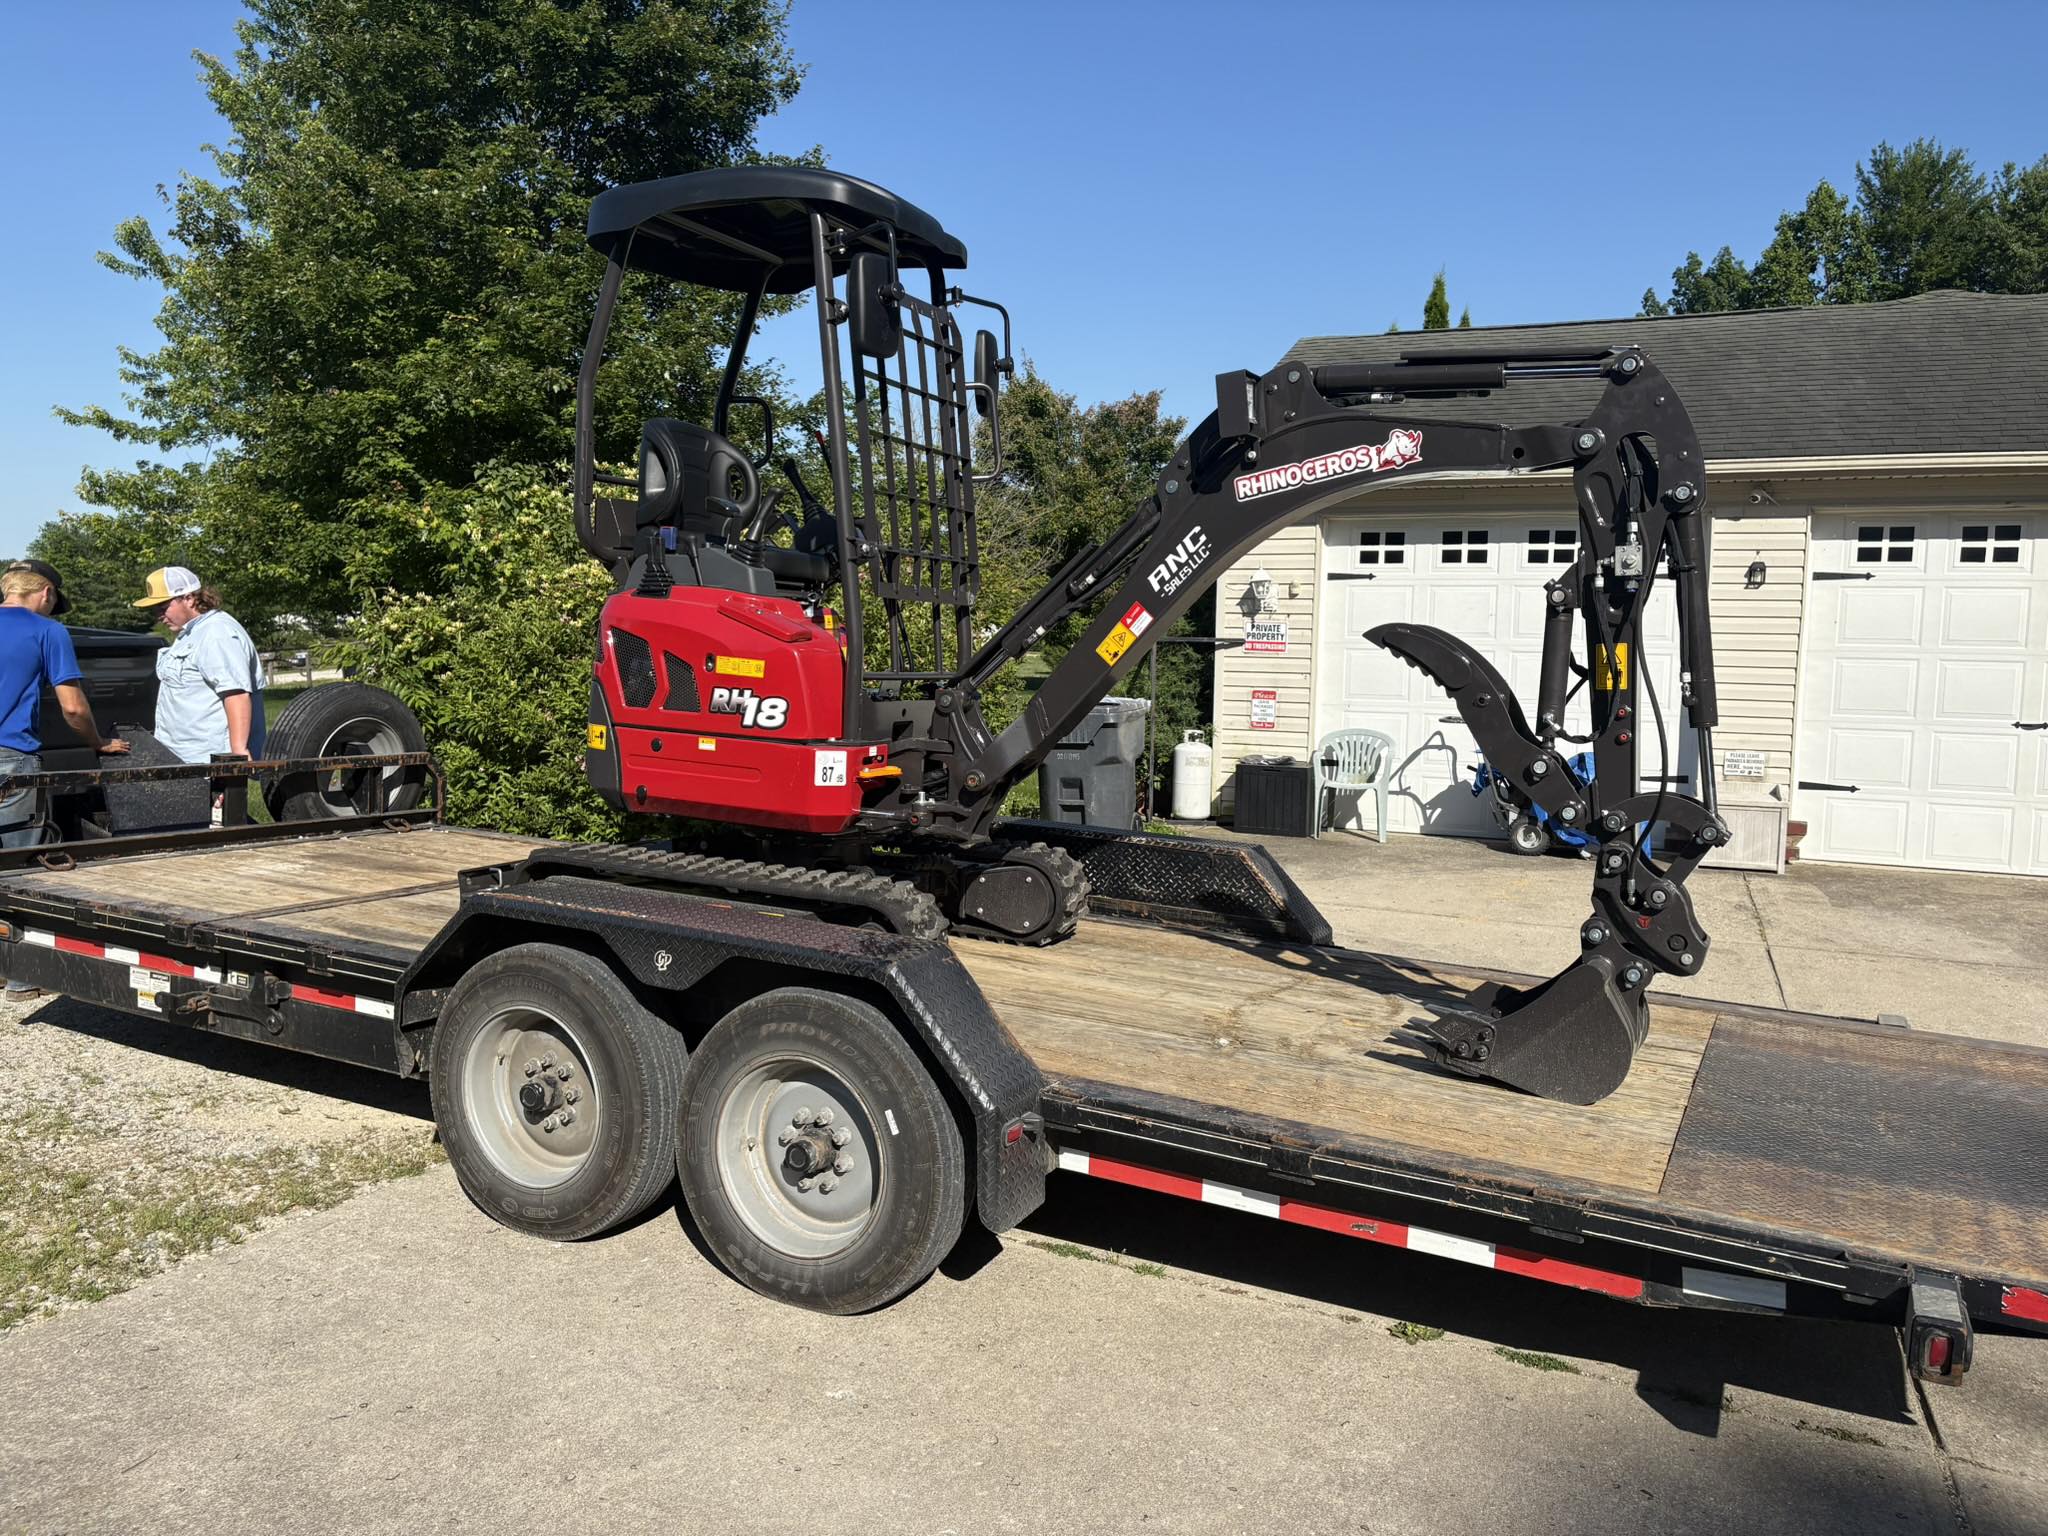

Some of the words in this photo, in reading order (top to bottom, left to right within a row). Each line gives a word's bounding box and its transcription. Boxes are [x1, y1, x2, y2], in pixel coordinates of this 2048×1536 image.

[1237, 446, 1371, 499] RHINOCEROS
[1147, 525, 1207, 592] ANC
[1251, 623, 1281, 632] PRIVATE
[1246, 632, 1285, 641] PROPERTY
[1253, 691, 1275, 699] Please
[821, 766, 835, 783] 87
[759, 1021, 890, 1095] PROVIDER
